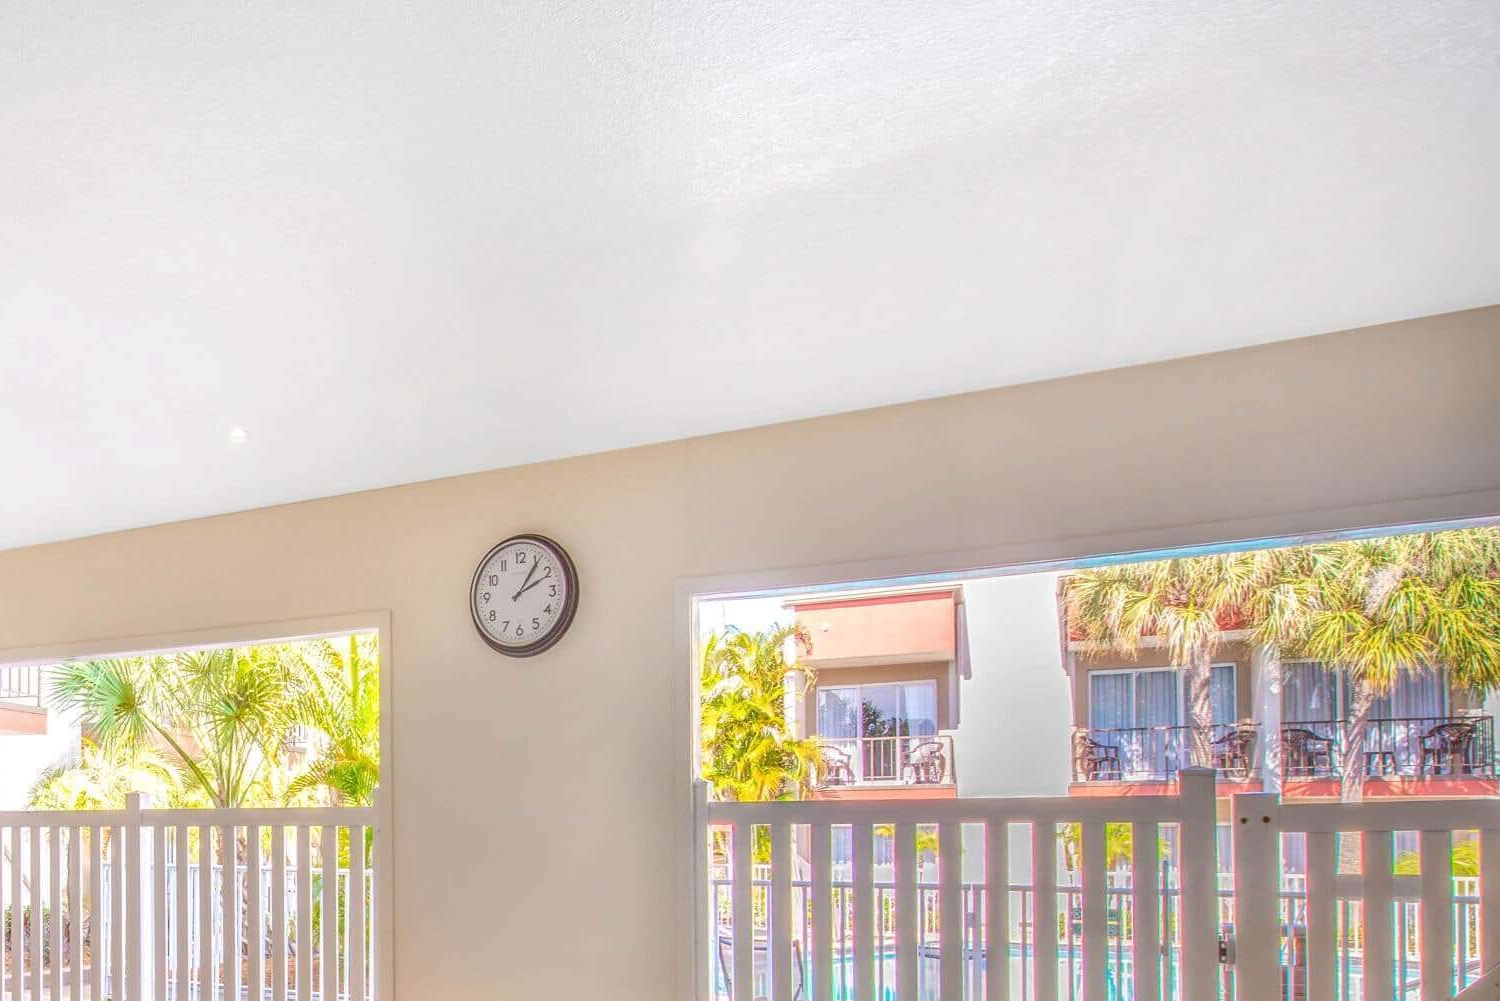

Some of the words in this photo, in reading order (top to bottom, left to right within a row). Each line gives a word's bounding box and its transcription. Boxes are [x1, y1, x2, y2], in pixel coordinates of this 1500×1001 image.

[516, 552, 526, 564] 12
[501, 560, 507, 572] 11
[543, 566, 551, 577] 2
[489, 575, 498, 586] 10
[549, 585, 556, 597] 3
[483, 592, 491, 603] 9
[543, 604, 551, 615] 4
[489, 610, 496, 621] 8
[503, 621, 509, 632] 7
[532, 618, 539, 630] 5
[516, 624, 523, 636] 6
